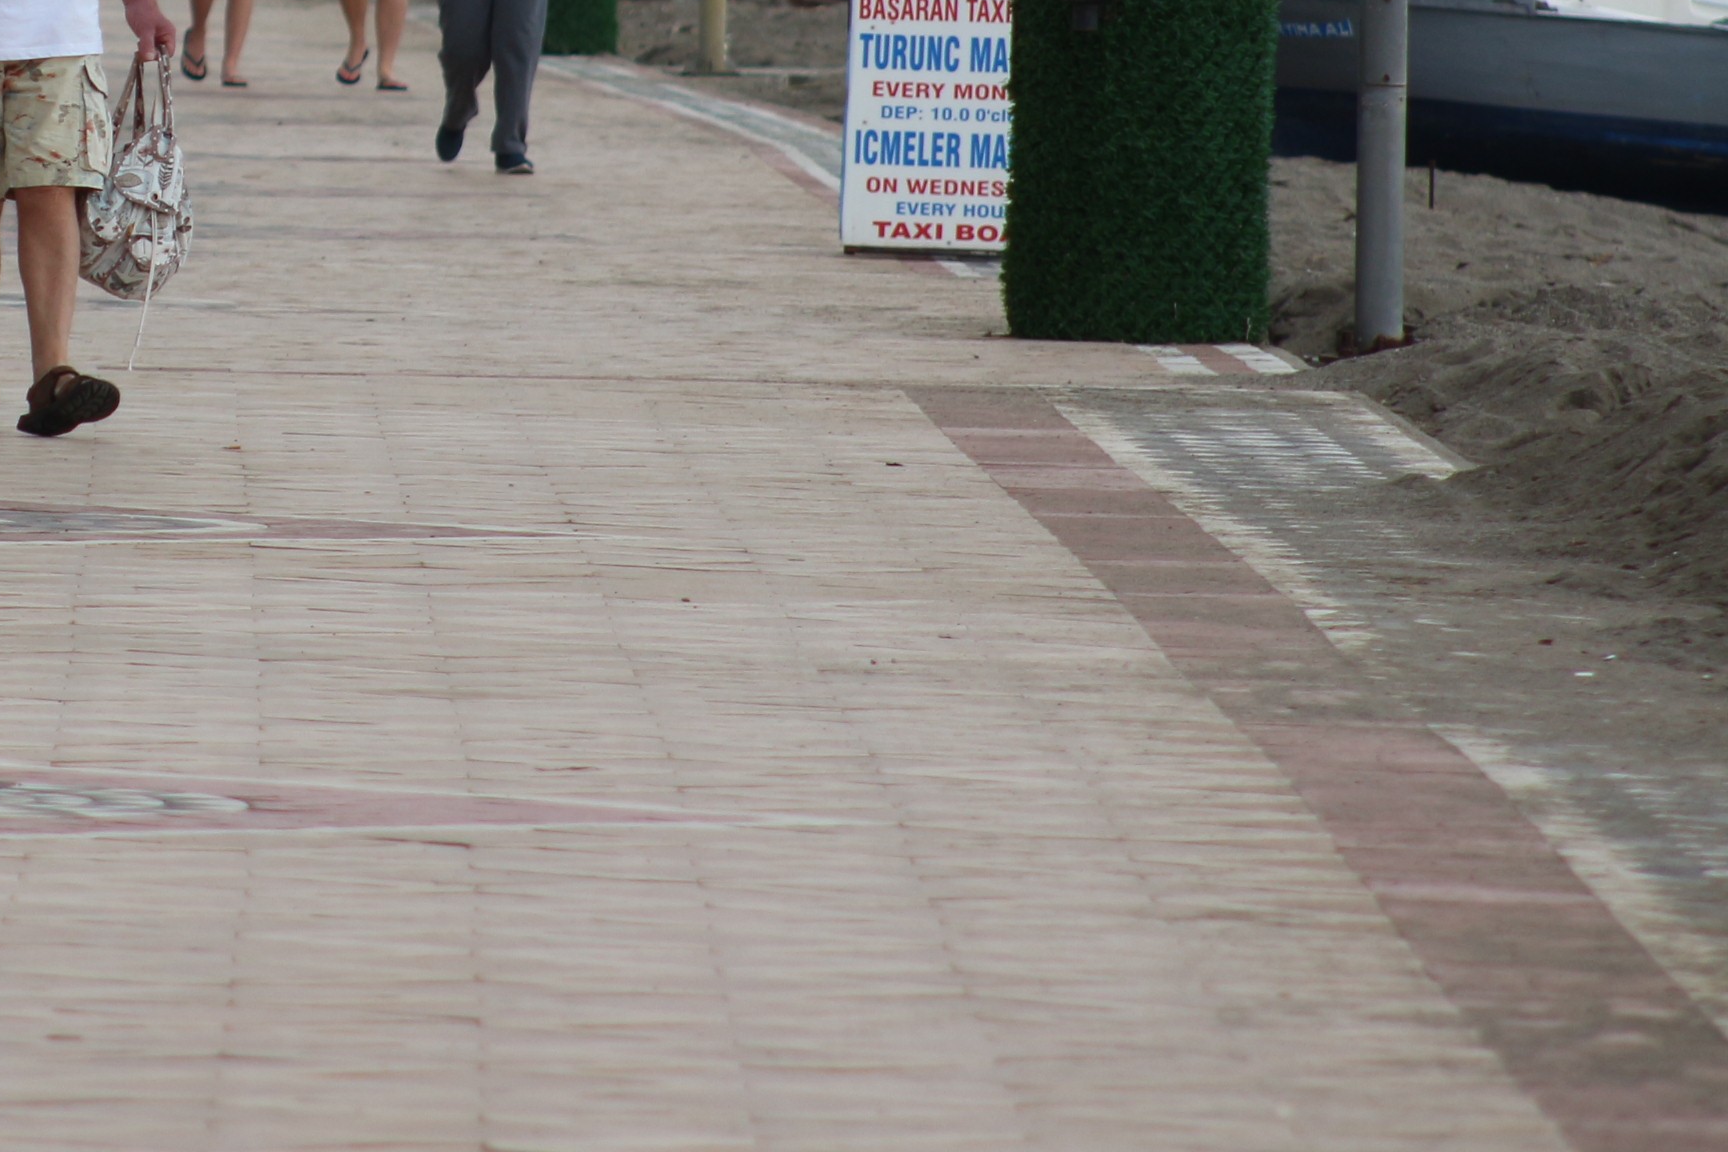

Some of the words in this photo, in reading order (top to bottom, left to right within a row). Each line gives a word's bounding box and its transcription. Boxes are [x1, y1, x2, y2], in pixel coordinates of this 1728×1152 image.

[859, 33, 960, 72] TURUNC
[873, 81, 945, 99] EVERY
[880, 105, 923, 120] DEP:
[854, 129, 961, 168] ICMELER
[866, 176, 898, 194] ON
[896, 201, 956, 217] EVERY
[872, 221, 943, 240] TAXI
